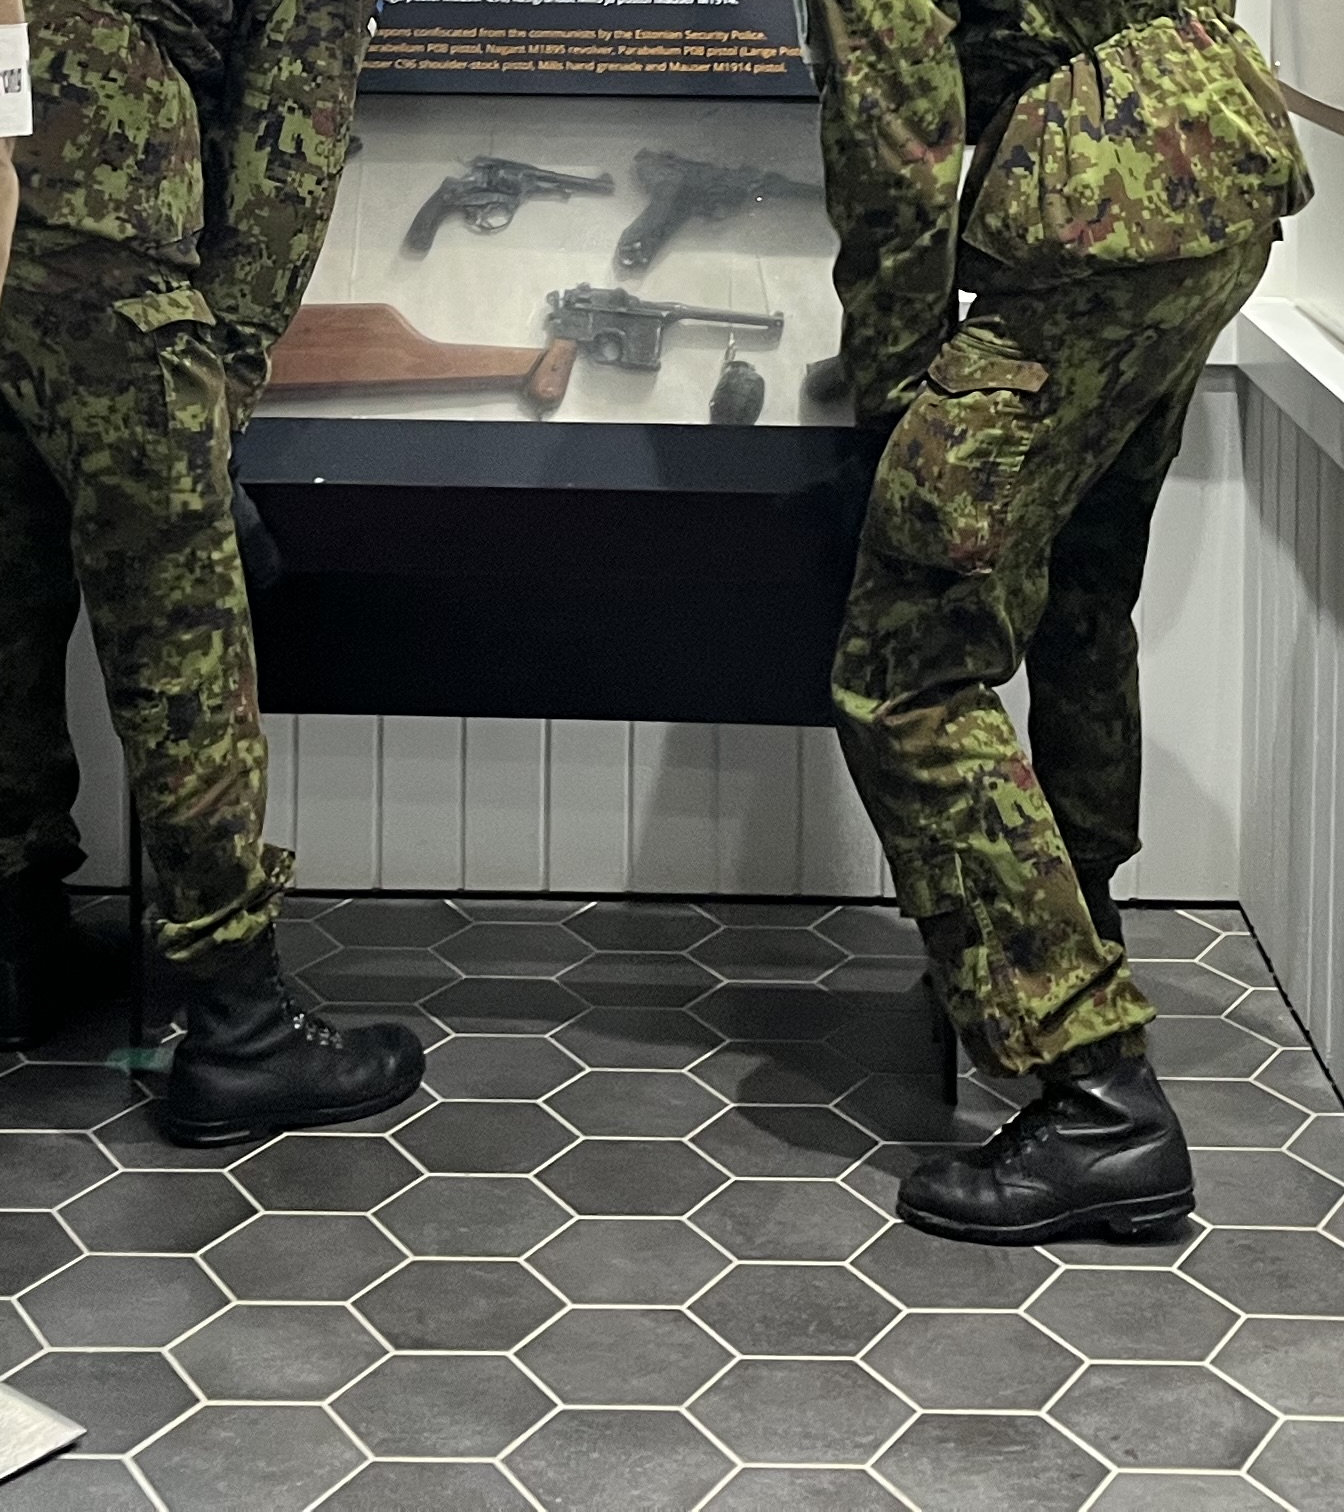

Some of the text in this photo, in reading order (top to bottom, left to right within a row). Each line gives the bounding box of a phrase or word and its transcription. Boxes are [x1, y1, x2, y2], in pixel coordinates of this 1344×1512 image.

[478, 28, 506, 38] from
[507, 28, 526, 38] the
[598, 29, 613, 41] by
[614, 30, 633, 39] the
[644, 62, 667, 72] and
[668, 62, 711, 72] Mauser
